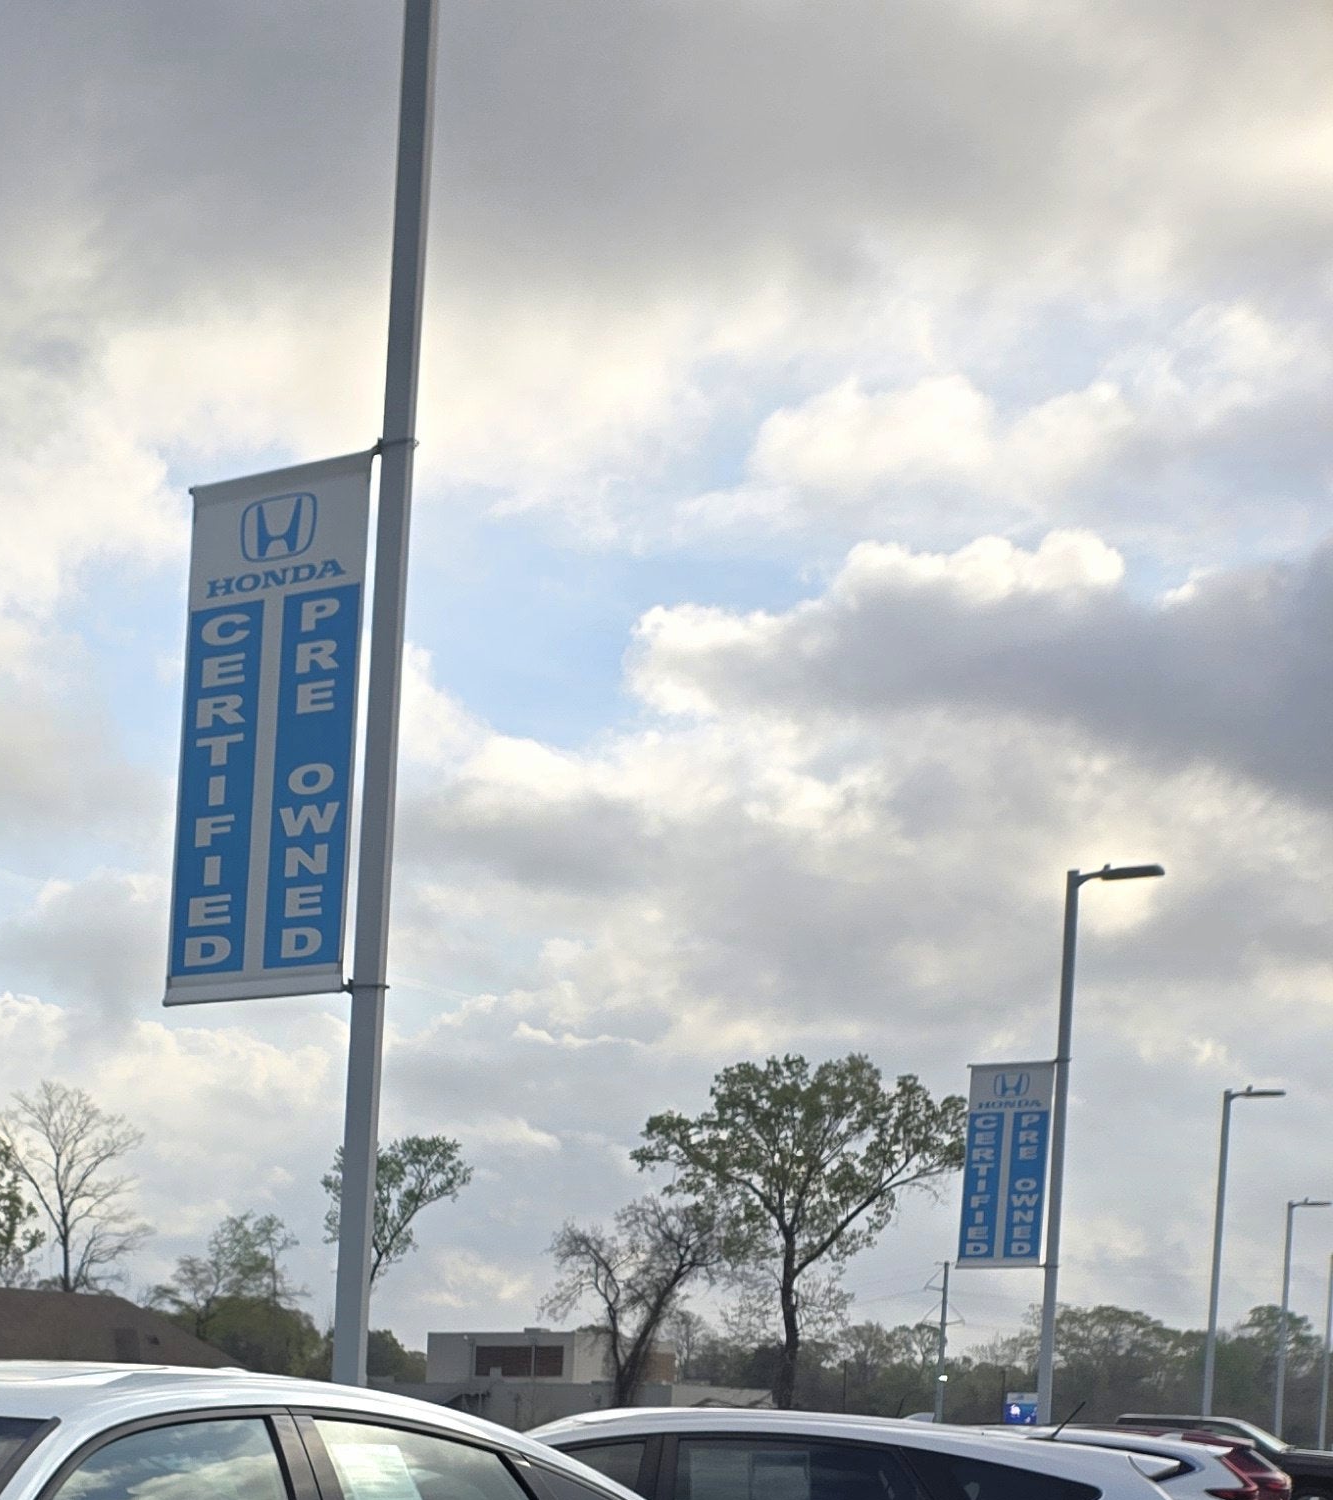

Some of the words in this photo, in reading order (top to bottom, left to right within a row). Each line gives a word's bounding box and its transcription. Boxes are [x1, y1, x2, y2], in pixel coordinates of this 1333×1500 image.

[205, 558, 347, 600] HONDA
[294, 597, 340, 715] PRE
[183, 612, 252, 969] CERTIFIED
[278, 762, 340, 960] OWNED
[977, 1099, 1042, 1109] HONDA
[1018, 1113, 1040, 1161] PRE
[964, 1114, 998, 1256] CERTIFIED
[1010, 1177, 1039, 1256] OWNED
